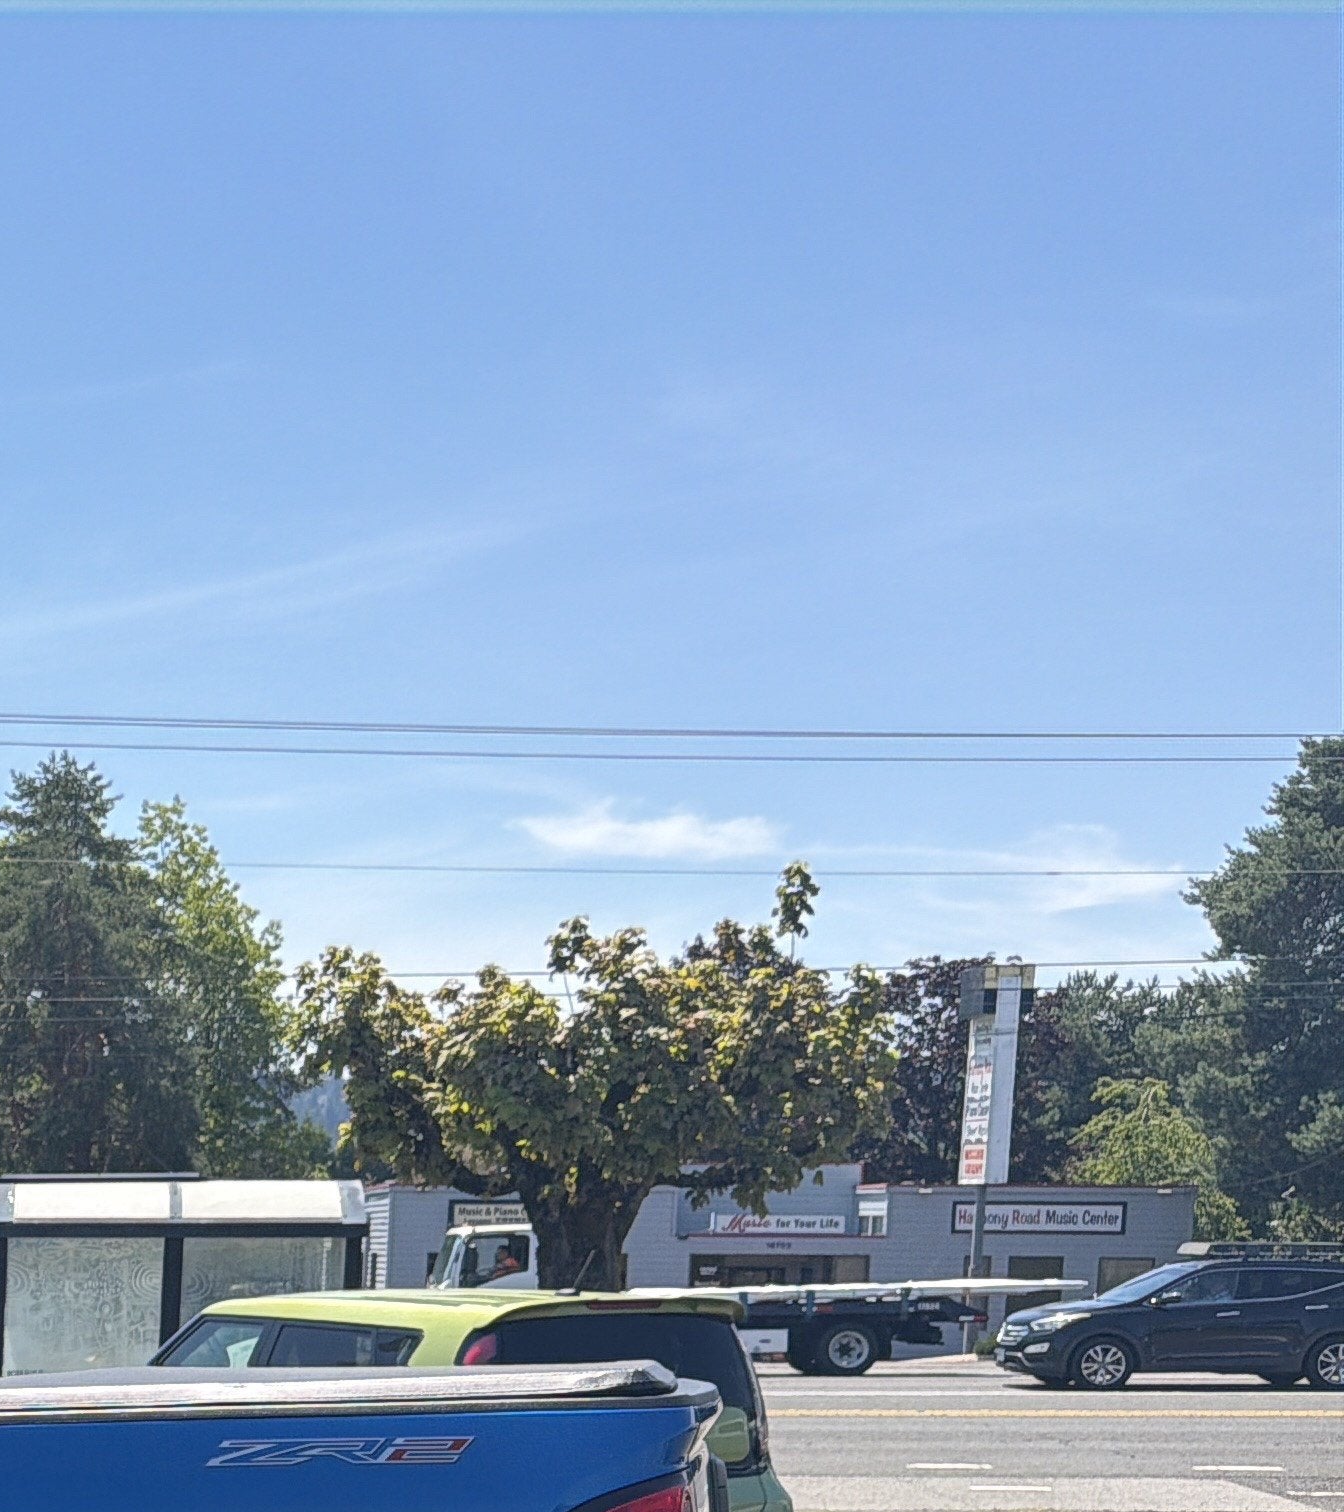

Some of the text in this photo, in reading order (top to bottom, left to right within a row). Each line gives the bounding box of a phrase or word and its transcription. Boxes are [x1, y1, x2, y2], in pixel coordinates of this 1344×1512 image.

[458, 1206, 483, 1216] Music
[484, 1207, 492, 1216] &
[493, 1206, 520, 1216] Piano
[775, 1218, 791, 1228] for
[794, 1218, 817, 1228] Your
[820, 1218, 840, 1229] Life
[958, 1209, 1120, 1230] Haony Road Music Center
[205, 1436, 475, 1467] ZR2
